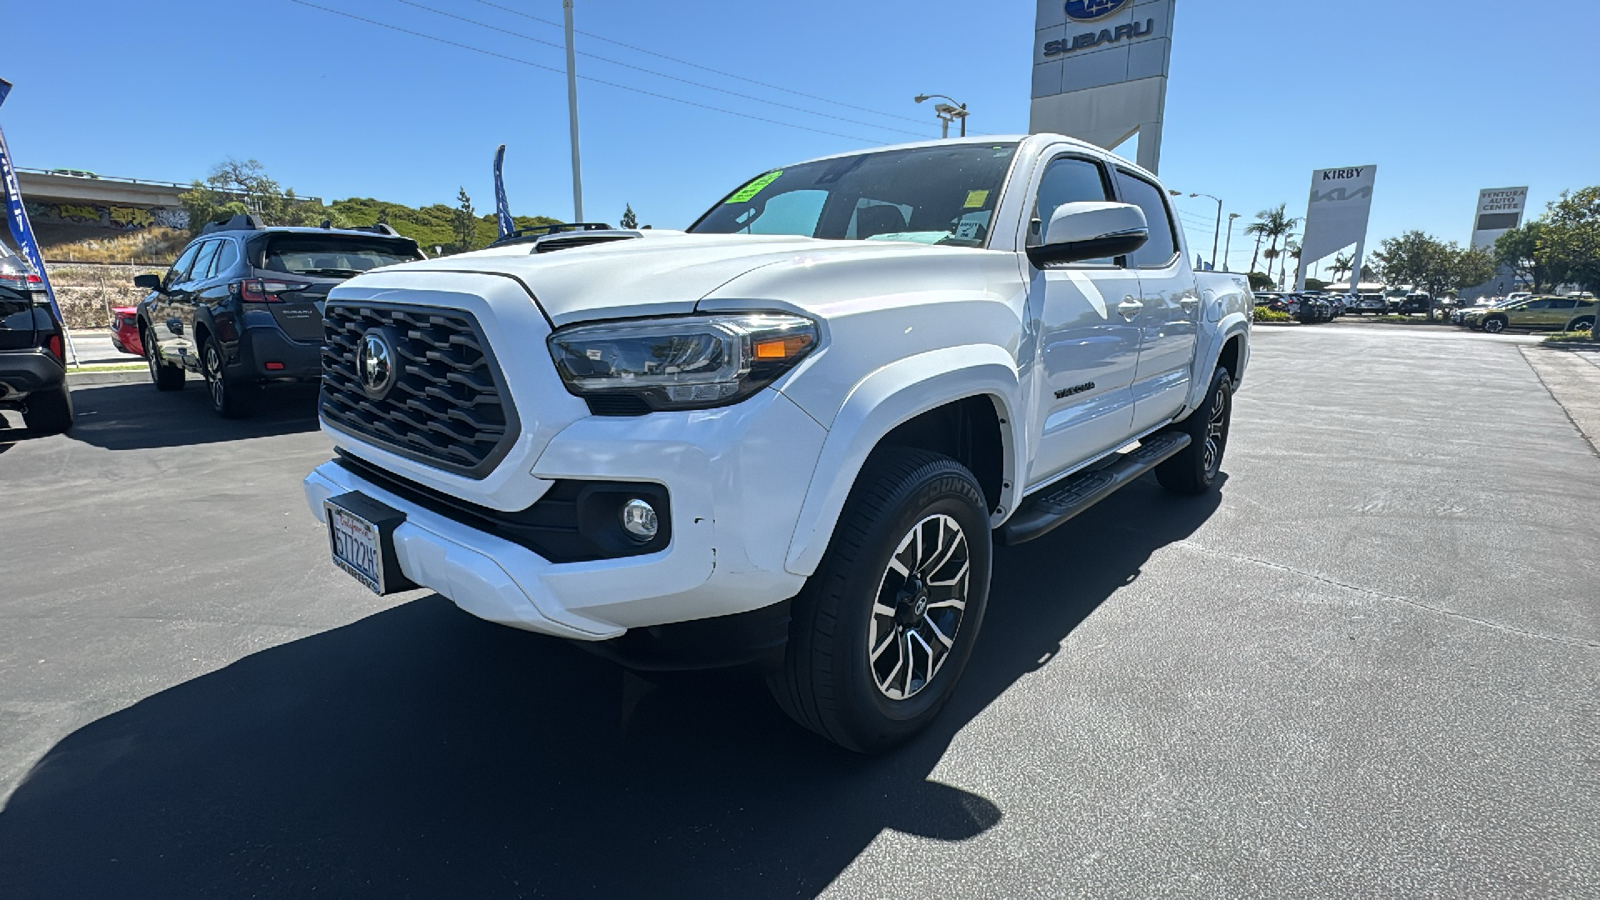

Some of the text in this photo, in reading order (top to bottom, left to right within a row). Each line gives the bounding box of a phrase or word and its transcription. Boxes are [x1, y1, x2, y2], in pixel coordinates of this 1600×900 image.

[1043, 18, 1153, 57] SUBARU
[1322, 167, 1364, 181] KIRBY
[1481, 190, 1525, 198] VENTURA
[1482, 203, 1519, 211] CENTER
